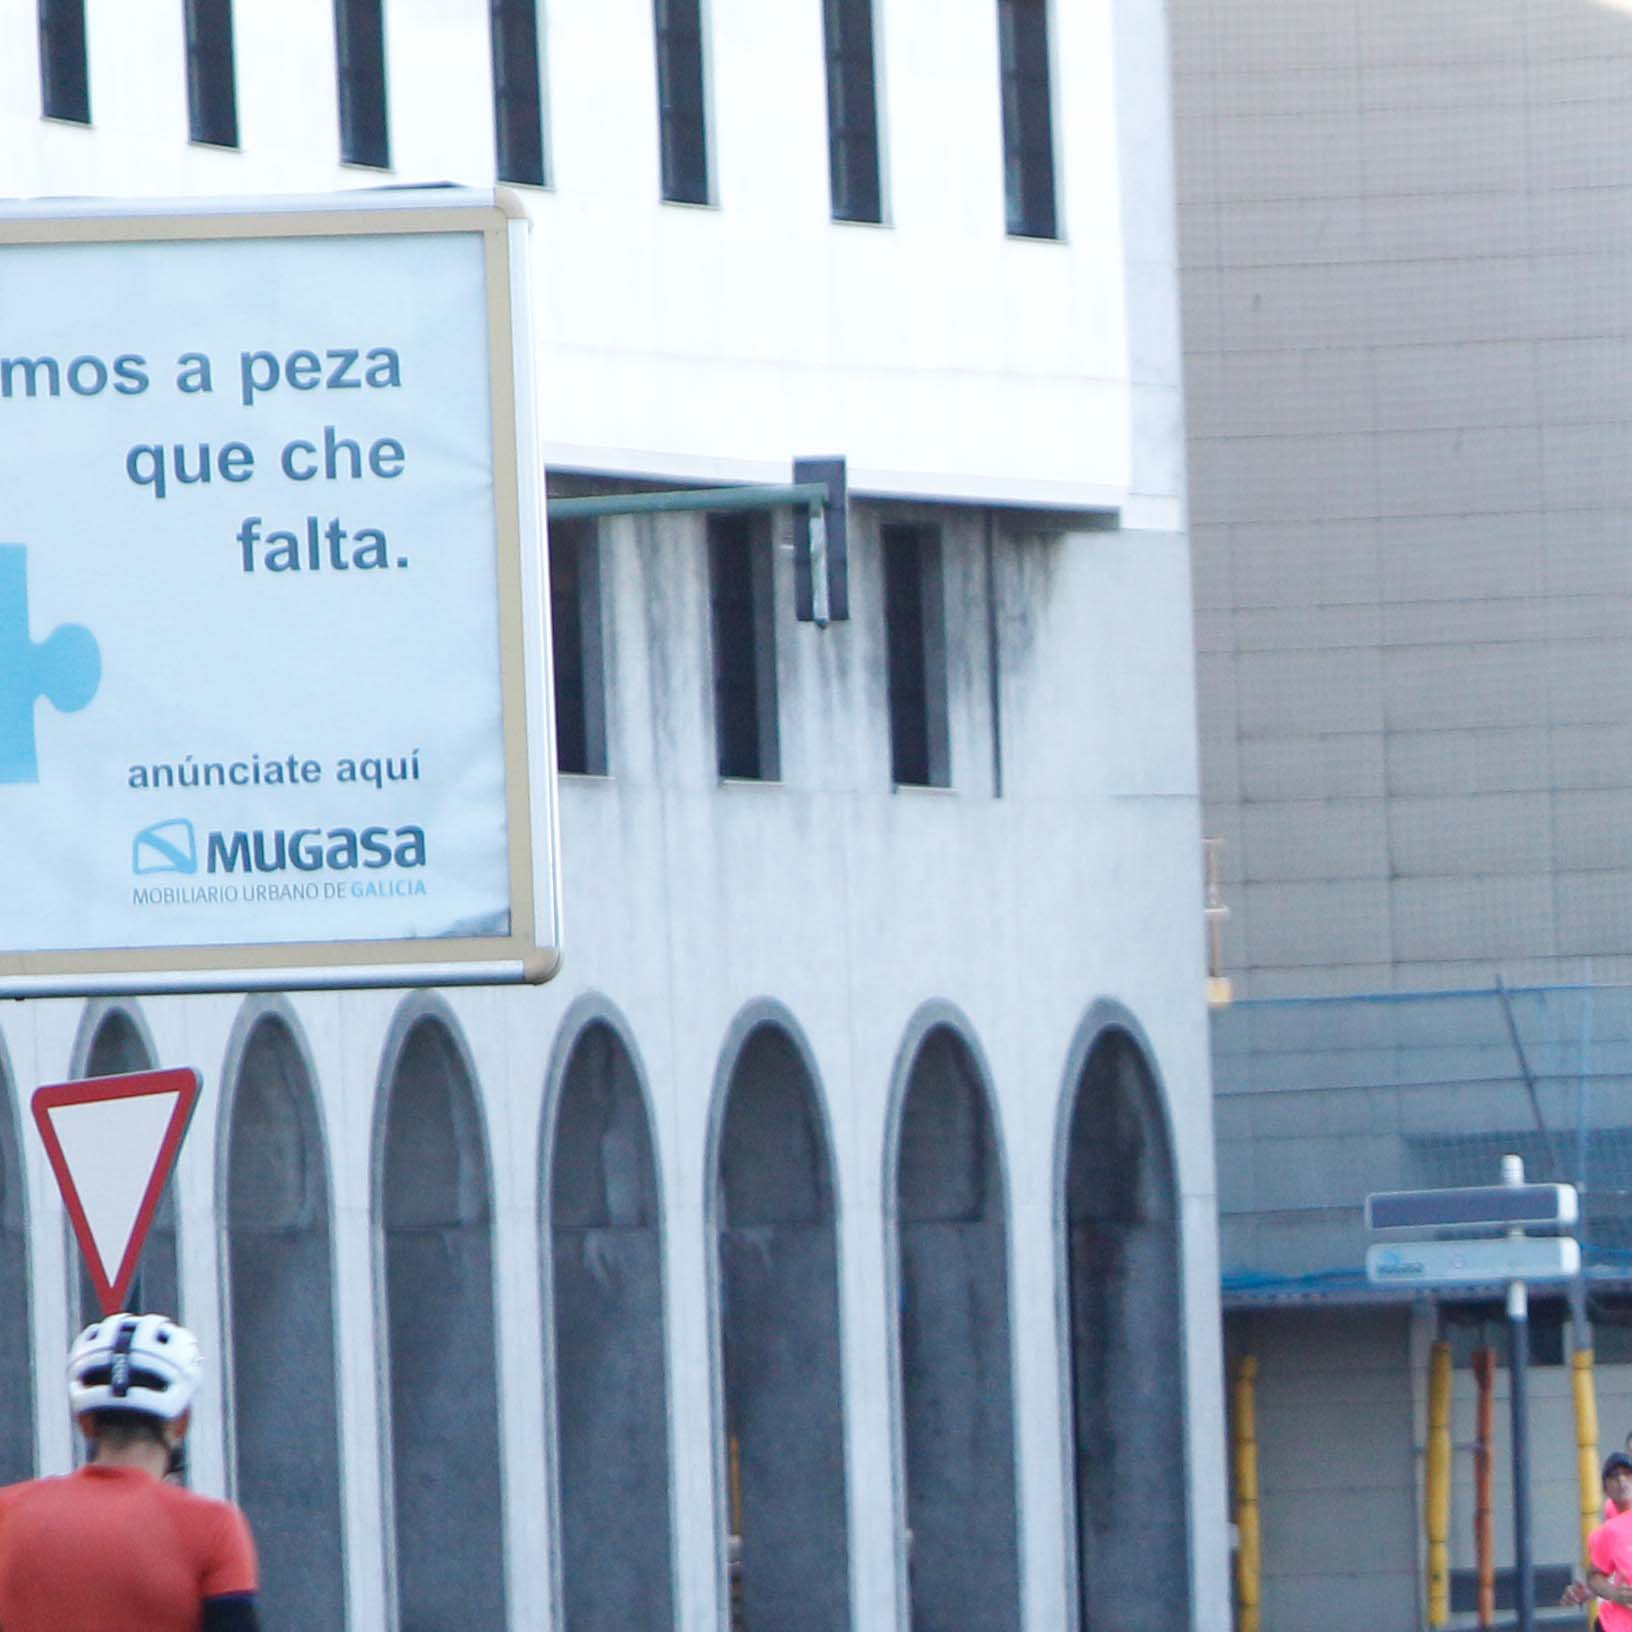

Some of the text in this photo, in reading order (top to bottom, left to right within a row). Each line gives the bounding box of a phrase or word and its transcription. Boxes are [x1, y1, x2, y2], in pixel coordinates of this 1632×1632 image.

[176, 351, 213, 394] a
[240, 346, 403, 406] peza
[126, 425, 406, 499] que che
[236, 516, 408, 573] falta.
[128, 748, 421, 789] anúnciate aquí
[132, 879, 427, 905] MOBILIARIO URBANO DE GALICIA
